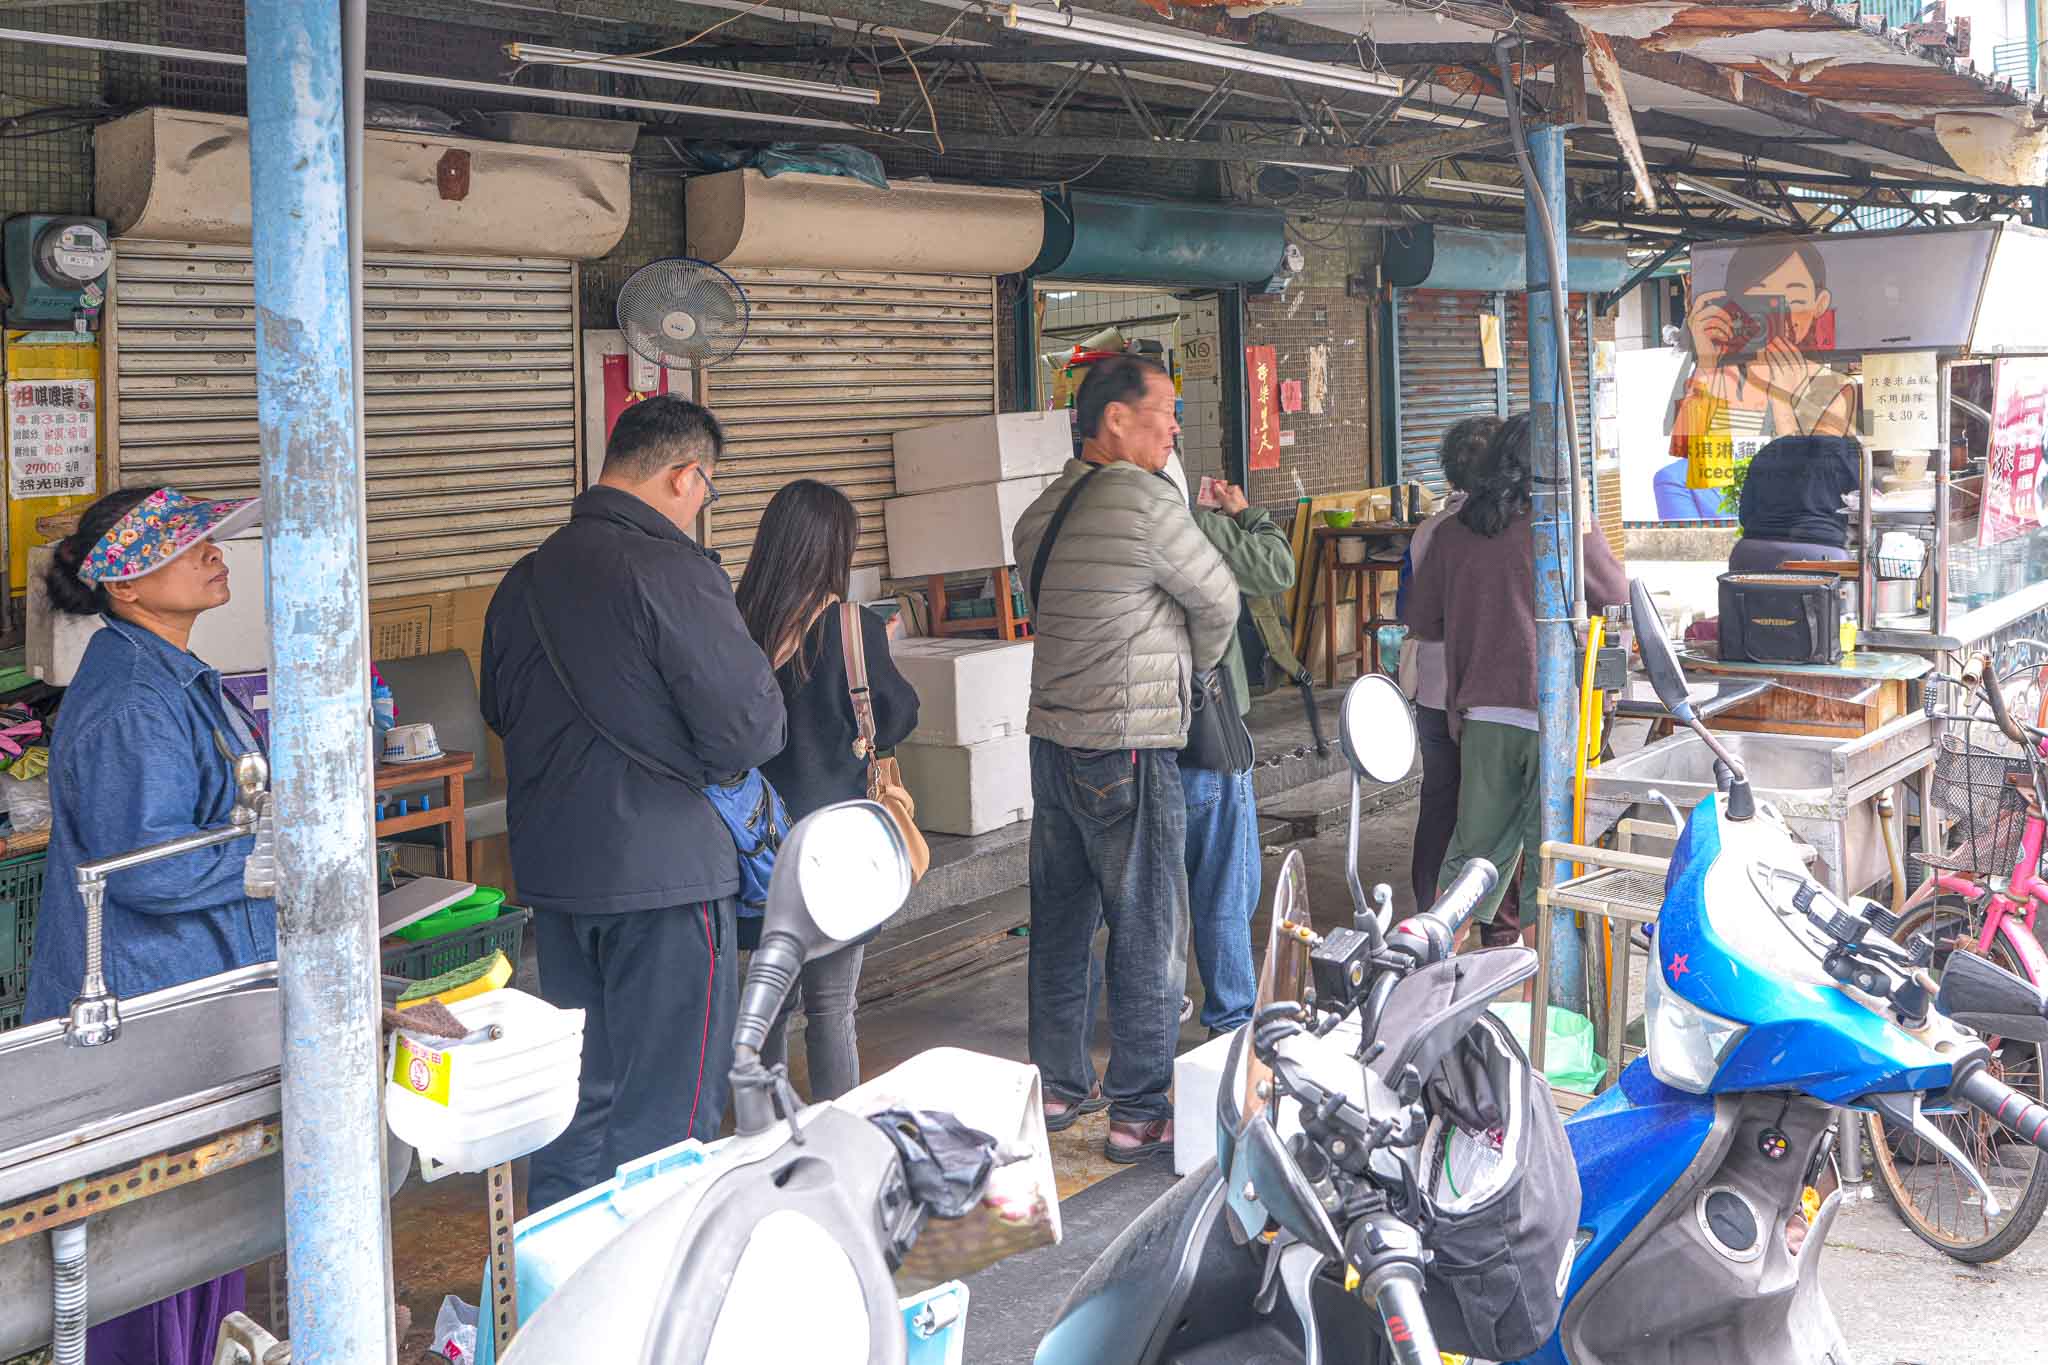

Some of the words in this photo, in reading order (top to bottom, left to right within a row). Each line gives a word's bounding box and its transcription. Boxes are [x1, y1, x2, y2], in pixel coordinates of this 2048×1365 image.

[1878, 393, 1924, 404] 不用排隊
[25, 463, 61, 475] 27000
